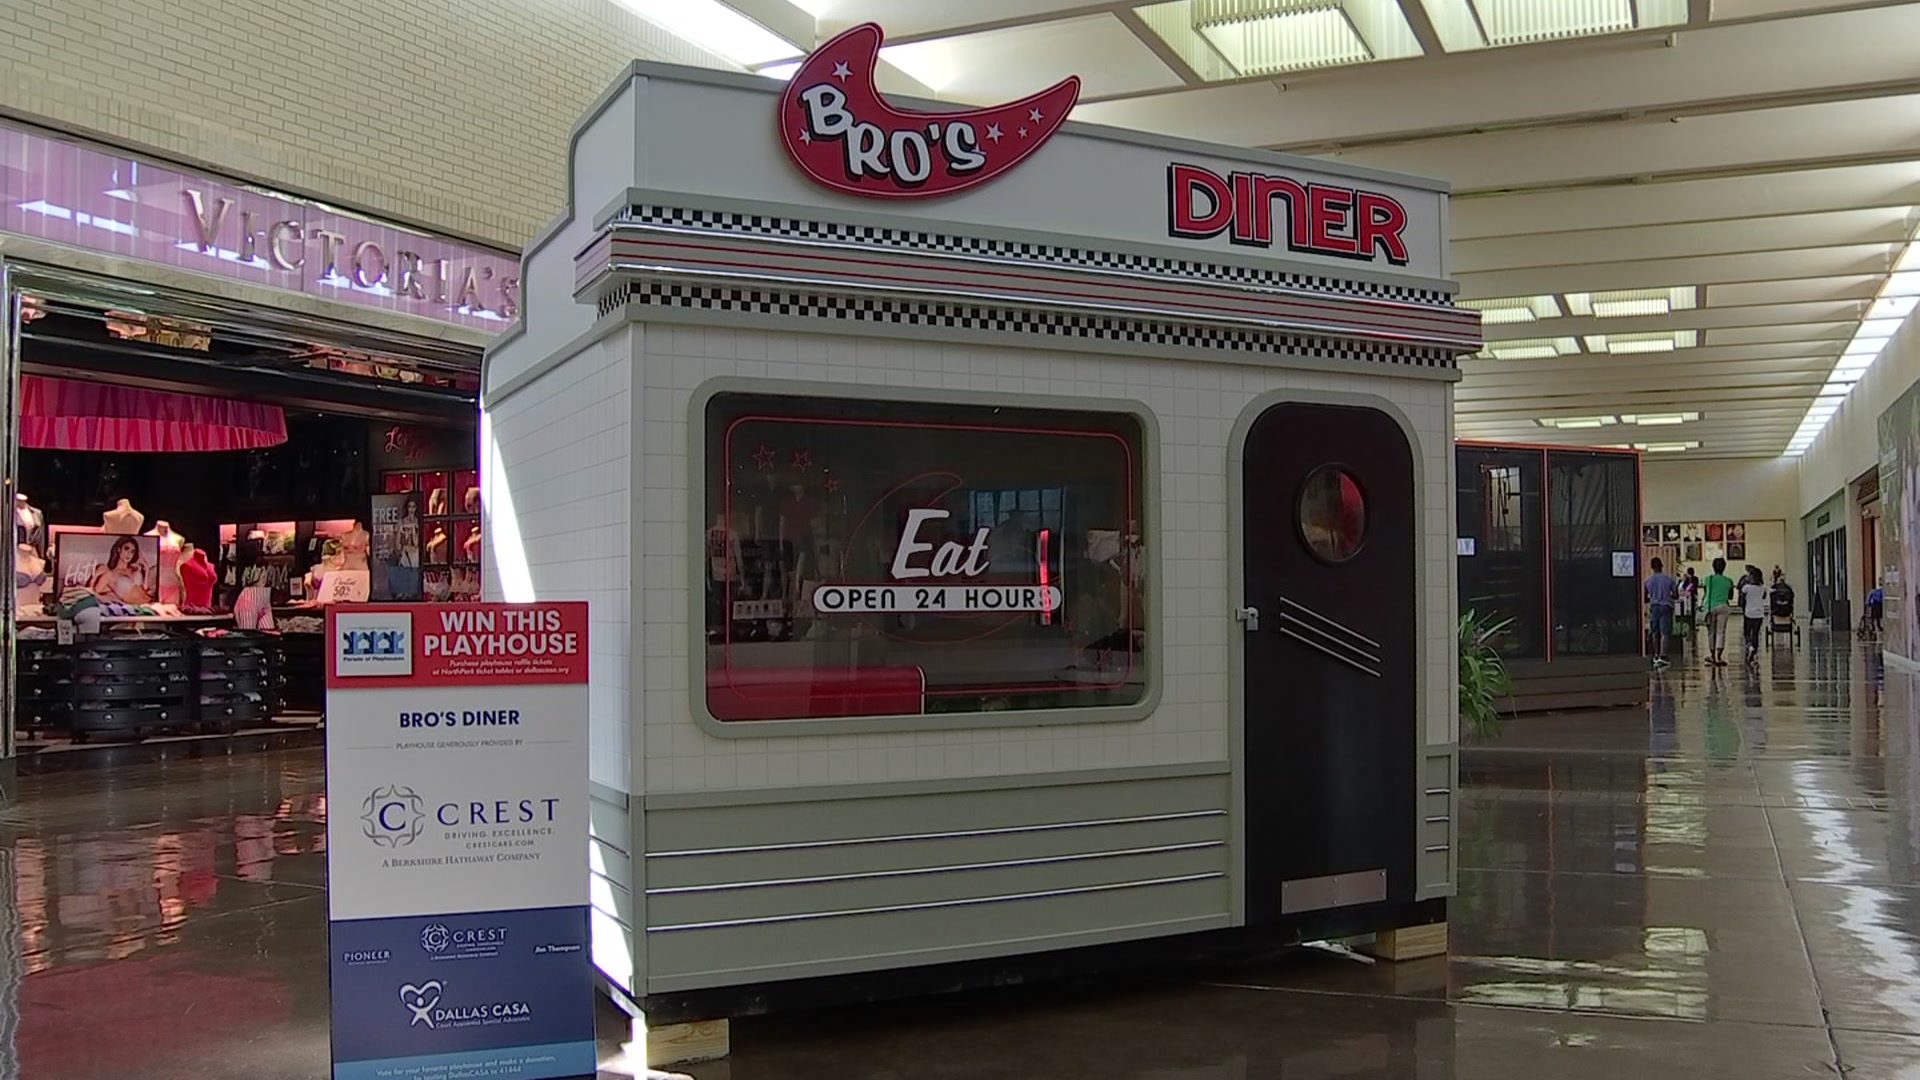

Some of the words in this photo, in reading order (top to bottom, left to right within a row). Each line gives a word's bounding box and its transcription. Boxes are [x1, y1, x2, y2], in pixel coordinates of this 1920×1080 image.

[800, 83, 986, 184] BRO'S
[1168, 162, 1409, 266] DINER
[185, 189, 521, 318] VICTORIA'S
[373, 506, 400, 523] FREE
[891, 508, 990, 579] Eat
[822, 588, 896, 609] OPEN
[914, 588, 947, 609] 24
[965, 588, 1051, 610] HOURS
[439, 610, 495, 633] WIN
[503, 609, 561, 632] THIS
[424, 633, 577, 656] PLAYHOUSE
[441, 668, 474, 676] NorthPark
[476, 667, 494, 675] ticket
[495, 667, 514, 675] tables
[480, 659, 513, 669] playhouse
[514, 658, 531, 666] raffle
[533, 658, 553, 666] tickets
[399, 711, 457, 728] BRO'S
[462, 709, 520, 726] DINER
[395, 741, 435, 750] PLAYHOUSE
[436, 740, 479, 749] GENEROUSLY
[480, 739, 513, 747] PROVIDED
[378, 801, 407, 832] C
[436, 798, 560, 826] CREST
[382, 859, 389, 868] A
[391, 857, 443, 868] BERKSHIRE
[445, 854, 495, 866] HATHAWAY
[496, 852, 541, 864] COMPANY
[452, 927, 508, 943] CREST
[343, 950, 391, 963] PIONEER
[435, 1005, 488, 1021] DALLAS
[492, 1002, 530, 1016] CASA
[452, 1019, 481, 1028] Appointed
[393, 1068, 404, 1076] for
[484, 1060, 497, 1068] and
